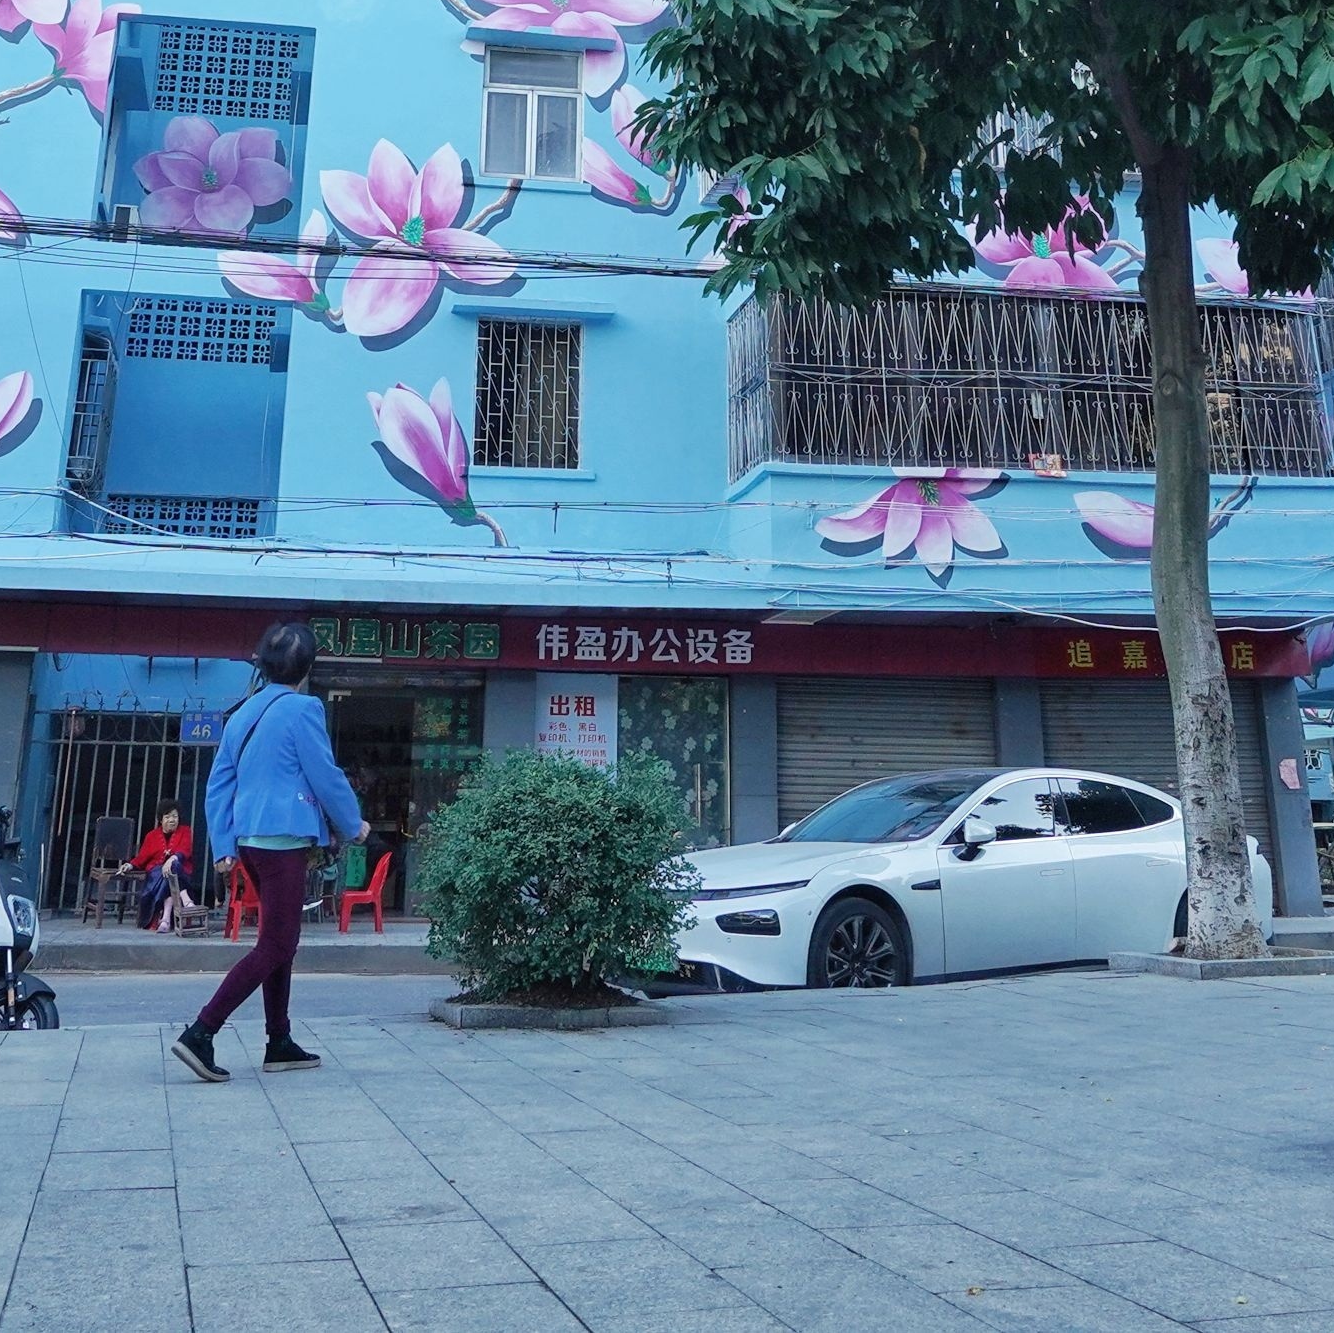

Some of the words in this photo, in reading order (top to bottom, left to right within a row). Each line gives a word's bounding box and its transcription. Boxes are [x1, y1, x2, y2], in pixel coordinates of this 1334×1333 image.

[308, 617, 500, 660] 凤凰山茶园
[536, 623, 756, 665] 伟盈办公设备
[1067, 639, 1254, 670] 追嘉店
[549, 694, 596, 717] 出租
[191, 723, 212, 739] 46
